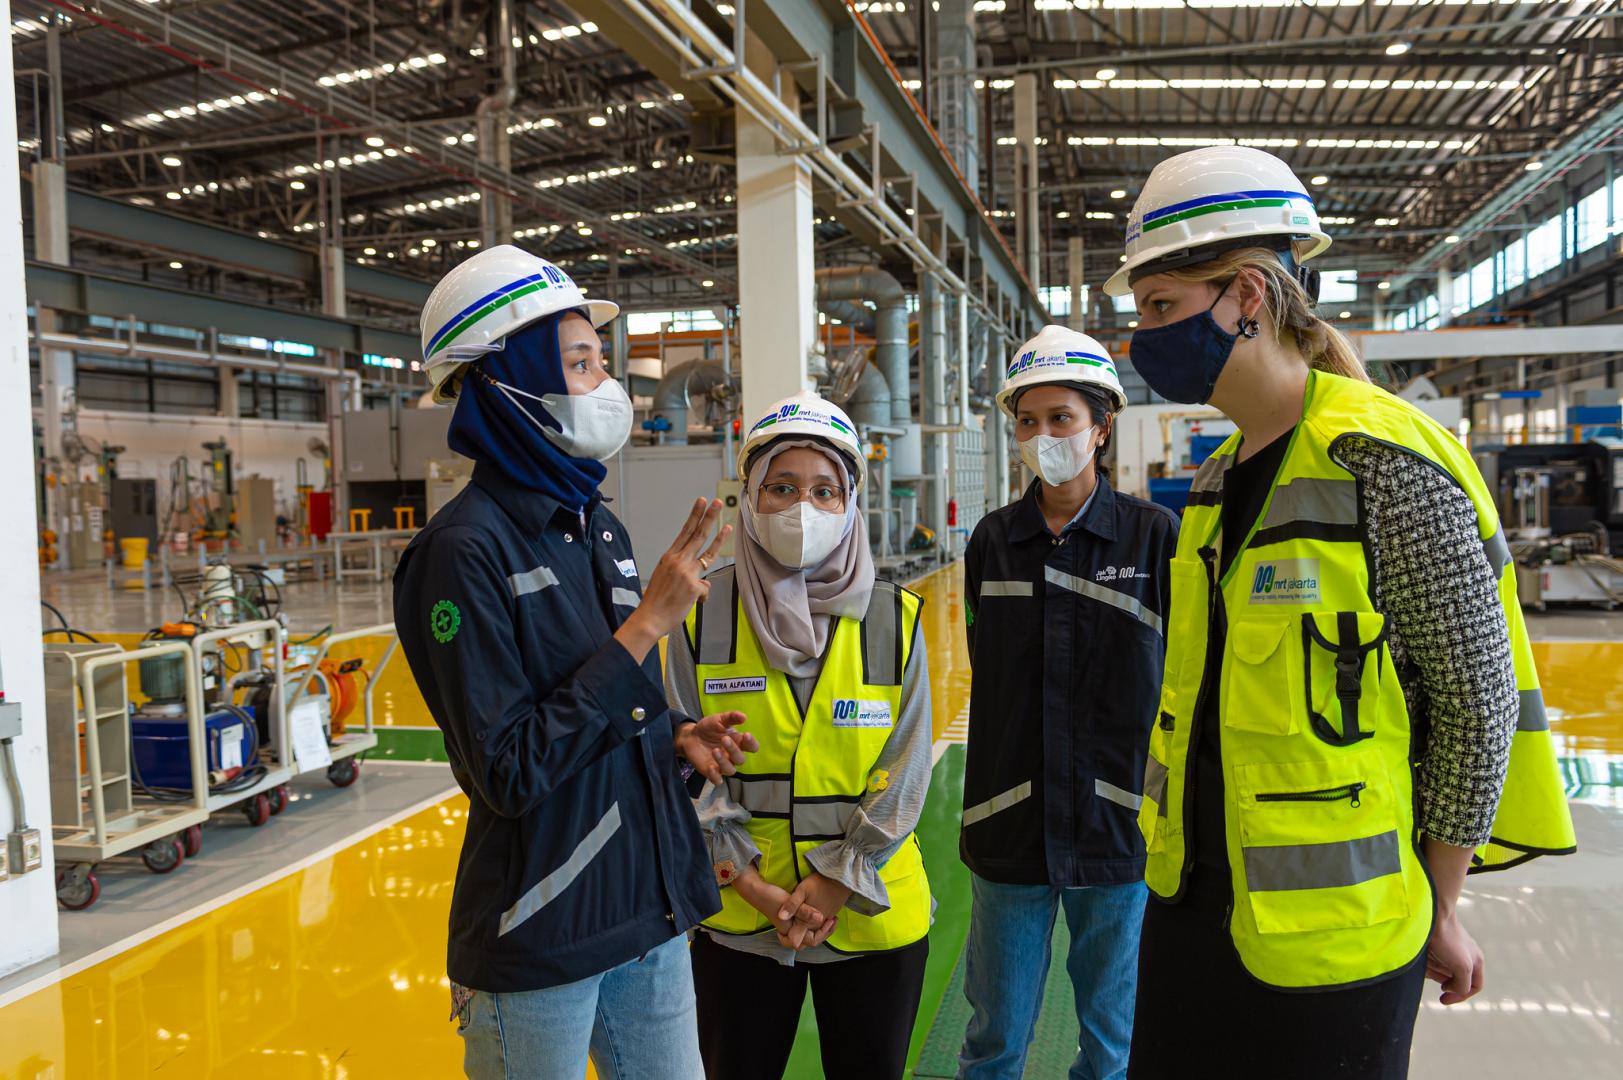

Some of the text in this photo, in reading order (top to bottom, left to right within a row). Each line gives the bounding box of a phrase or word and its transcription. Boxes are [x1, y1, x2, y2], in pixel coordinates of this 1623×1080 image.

[1274, 577, 1317, 592] mrt jakarta
[729, 680, 763, 688] ALFATIANI
